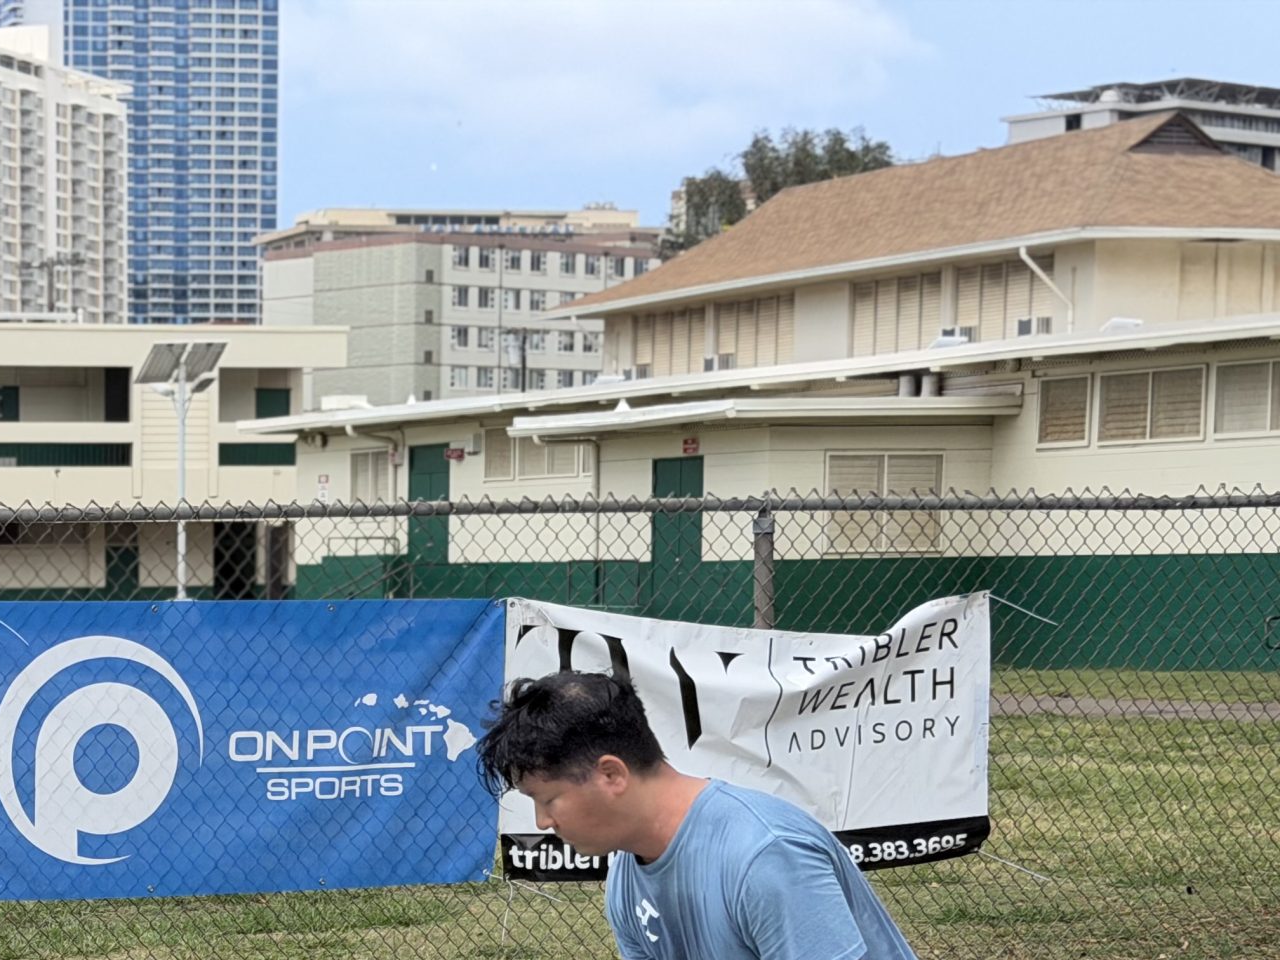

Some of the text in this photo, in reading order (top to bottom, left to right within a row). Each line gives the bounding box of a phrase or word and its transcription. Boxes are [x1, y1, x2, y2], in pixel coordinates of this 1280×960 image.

[798, 666, 955, 715] WEALTH
[788, 715, 960, 753] ADVISORY
[267, 774, 403, 800] SPORTS
